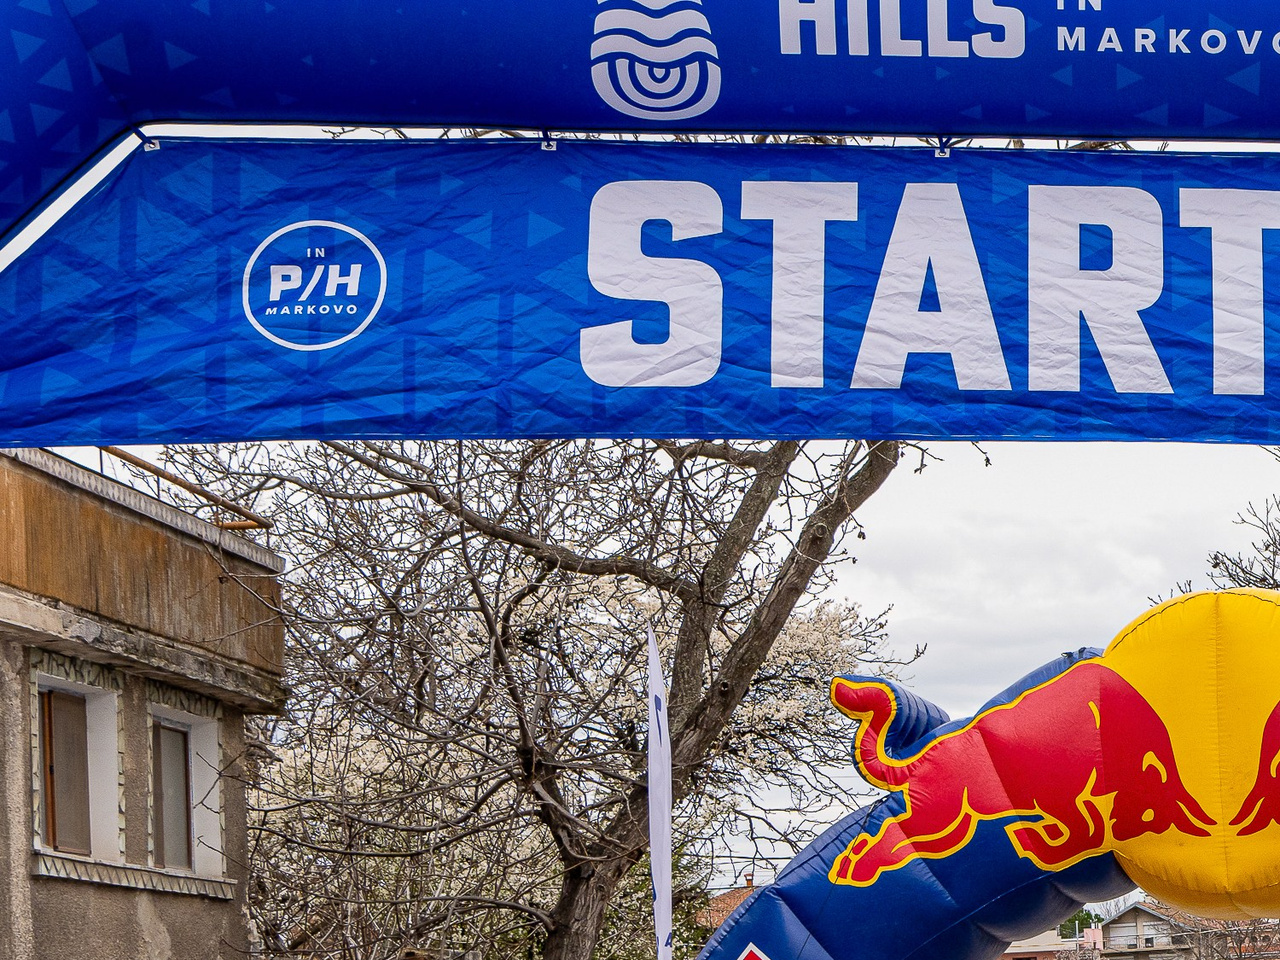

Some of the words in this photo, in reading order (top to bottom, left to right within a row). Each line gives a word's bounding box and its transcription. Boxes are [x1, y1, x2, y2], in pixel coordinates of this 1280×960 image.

[306, 247, 326, 258] IN
[269, 263, 362, 302] P/H
[265, 303, 358, 316] MARKOVO
